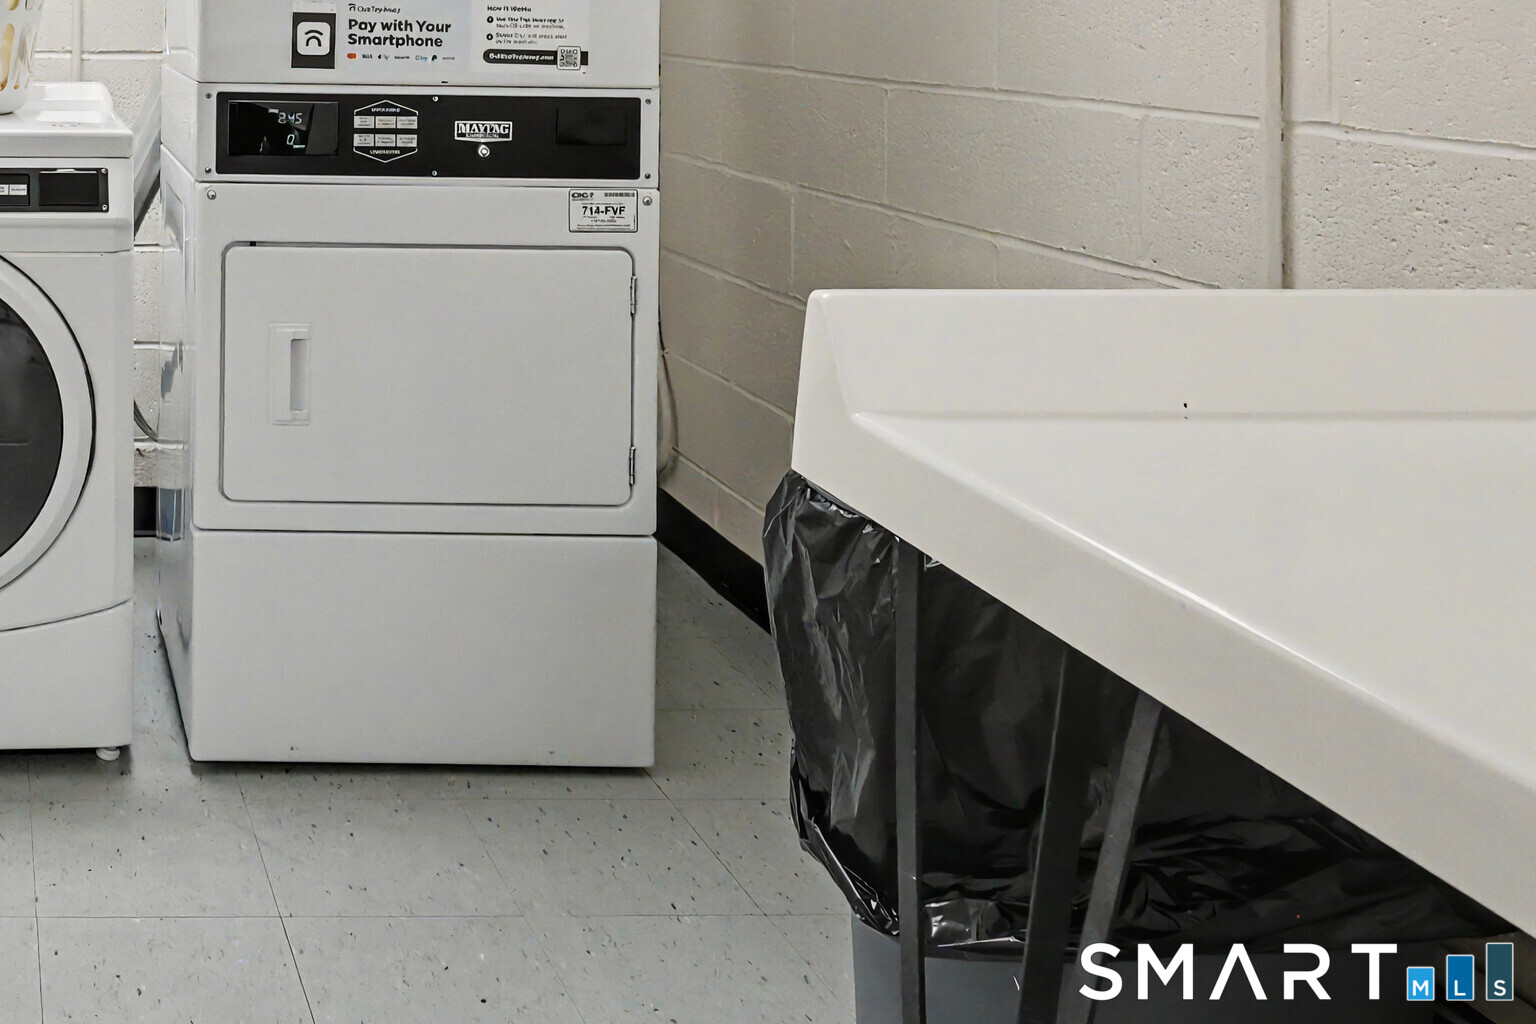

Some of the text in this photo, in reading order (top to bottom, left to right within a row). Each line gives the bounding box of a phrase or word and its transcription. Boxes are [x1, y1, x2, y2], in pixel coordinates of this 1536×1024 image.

[348, 18, 452, 33] Pay with Your
[347, 33, 443, 49] Smartphone
[458, 123, 510, 134] MAYTAG
[582, 205, 626, 216] 714-FVF
